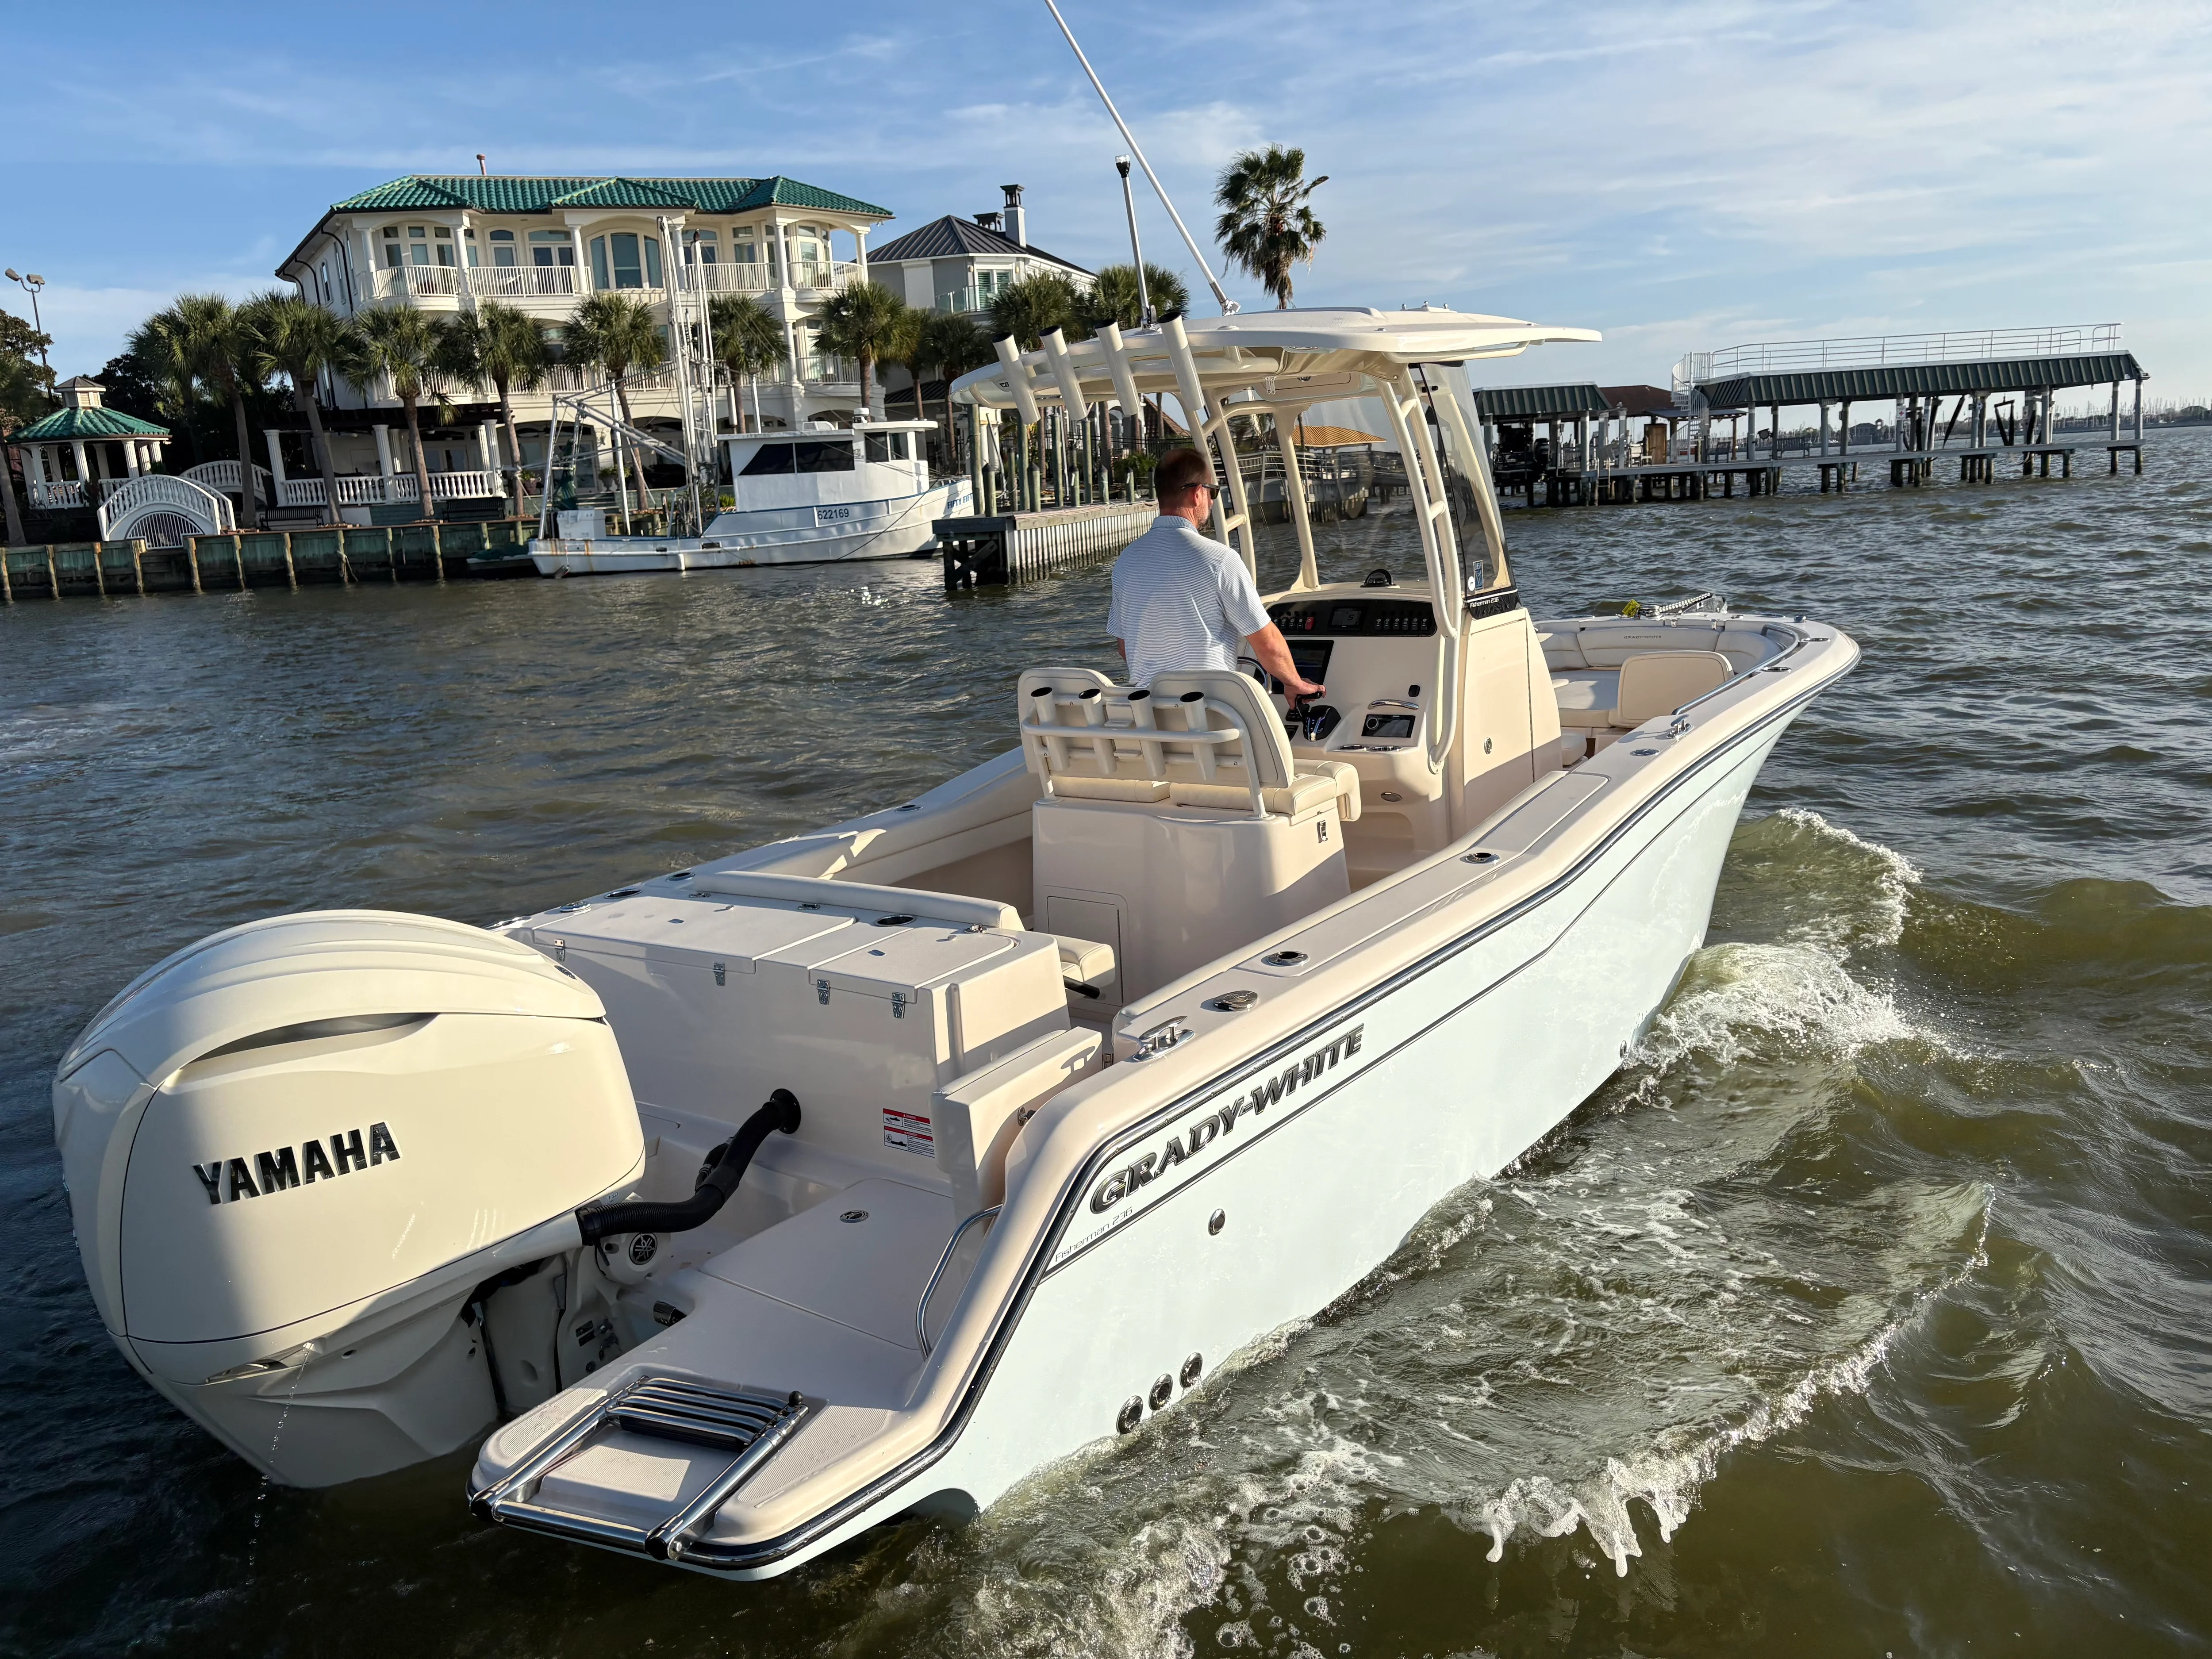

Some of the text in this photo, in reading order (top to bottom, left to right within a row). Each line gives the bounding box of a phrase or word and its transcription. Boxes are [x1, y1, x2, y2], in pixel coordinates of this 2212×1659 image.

[818, 508, 849, 520] 622169
[947, 493, 973, 509] FIFTY FIFT
[1090, 1023, 1364, 1214] GRADY-WHITE
[192, 1121, 403, 1205] YAMAHA
[1055, 1206, 1133, 1262] Fisherman 236
